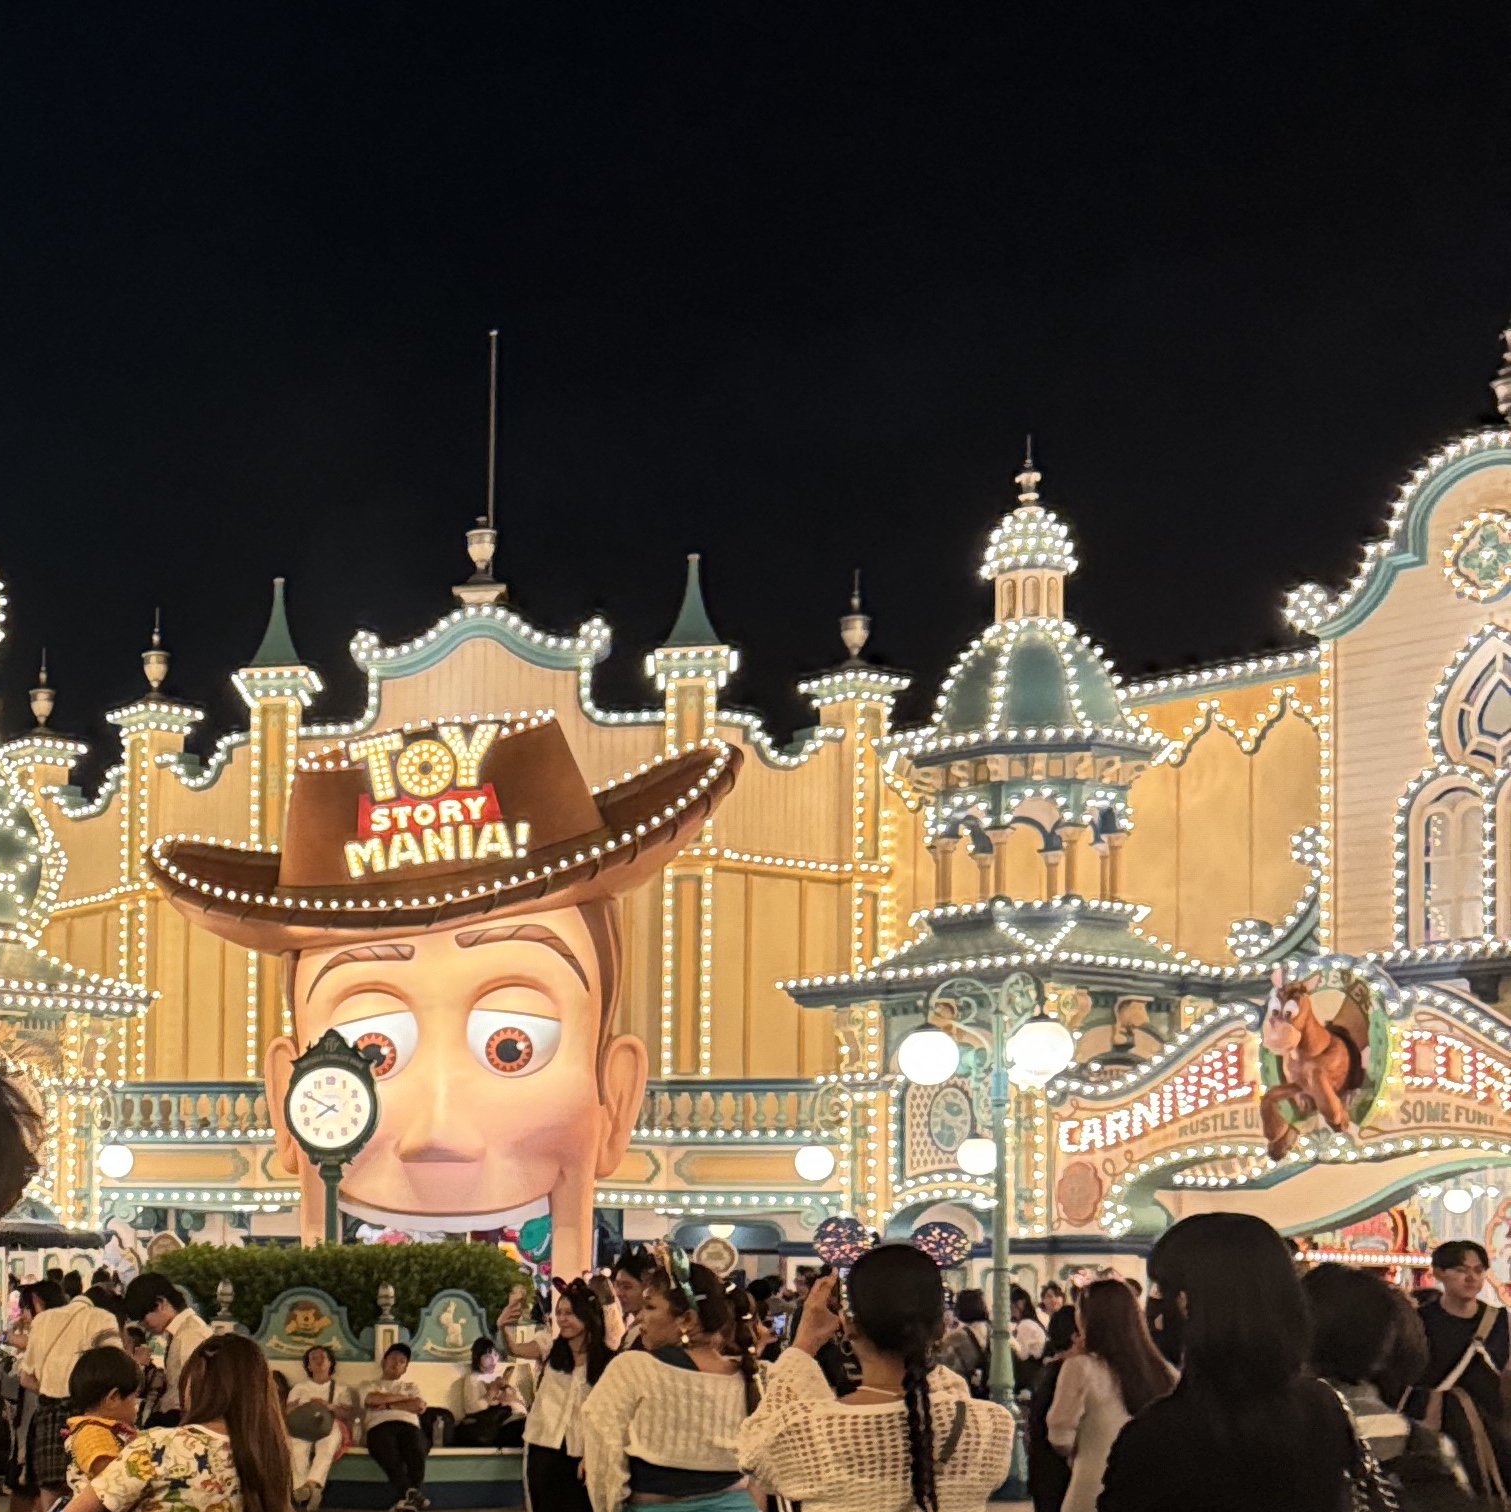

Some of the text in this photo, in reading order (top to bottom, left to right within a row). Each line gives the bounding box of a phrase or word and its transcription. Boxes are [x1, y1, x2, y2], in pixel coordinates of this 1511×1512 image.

[349, 724, 499, 801] TOY
[370, 796, 488, 832] STORY
[343, 821, 531, 879] MANIA!
[1058, 1041, 1256, 1153] CARNIVAL
[1178, 1109, 1240, 1138] RUSTLE
[1399, 1099, 1451, 1125] SOME
